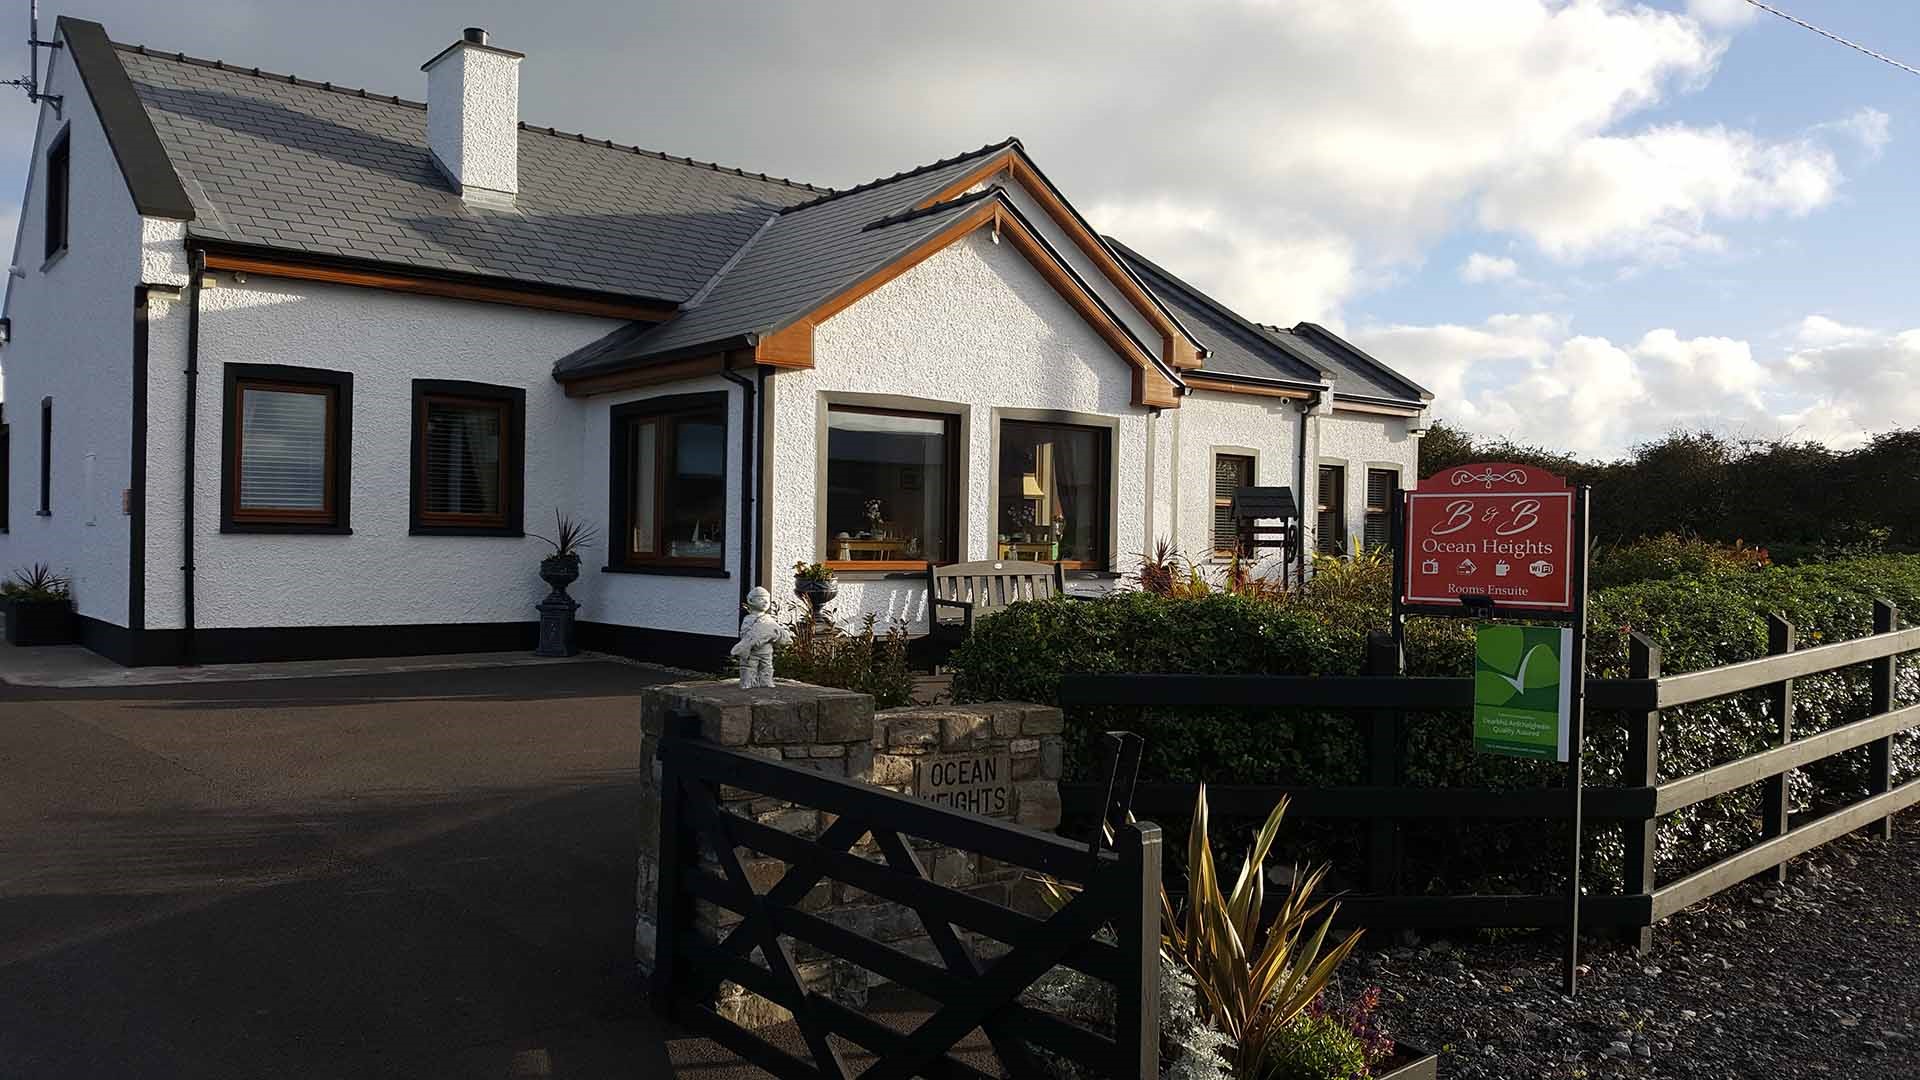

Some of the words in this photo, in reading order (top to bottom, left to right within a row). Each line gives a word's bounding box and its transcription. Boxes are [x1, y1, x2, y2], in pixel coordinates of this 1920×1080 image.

[1431, 499, 1474, 535] B
[1481, 507, 1499, 524] &
[1495, 499, 1541, 536] B
[1422, 538, 1477, 554] Ocean
[1482, 539, 1553, 560] Heights
[1448, 583, 1485, 595] Rooms
[1487, 584, 1529, 596] Ensuite
[930, 757, 997, 787] OCEAN
[923, 787, 1007, 814] IGHTS
